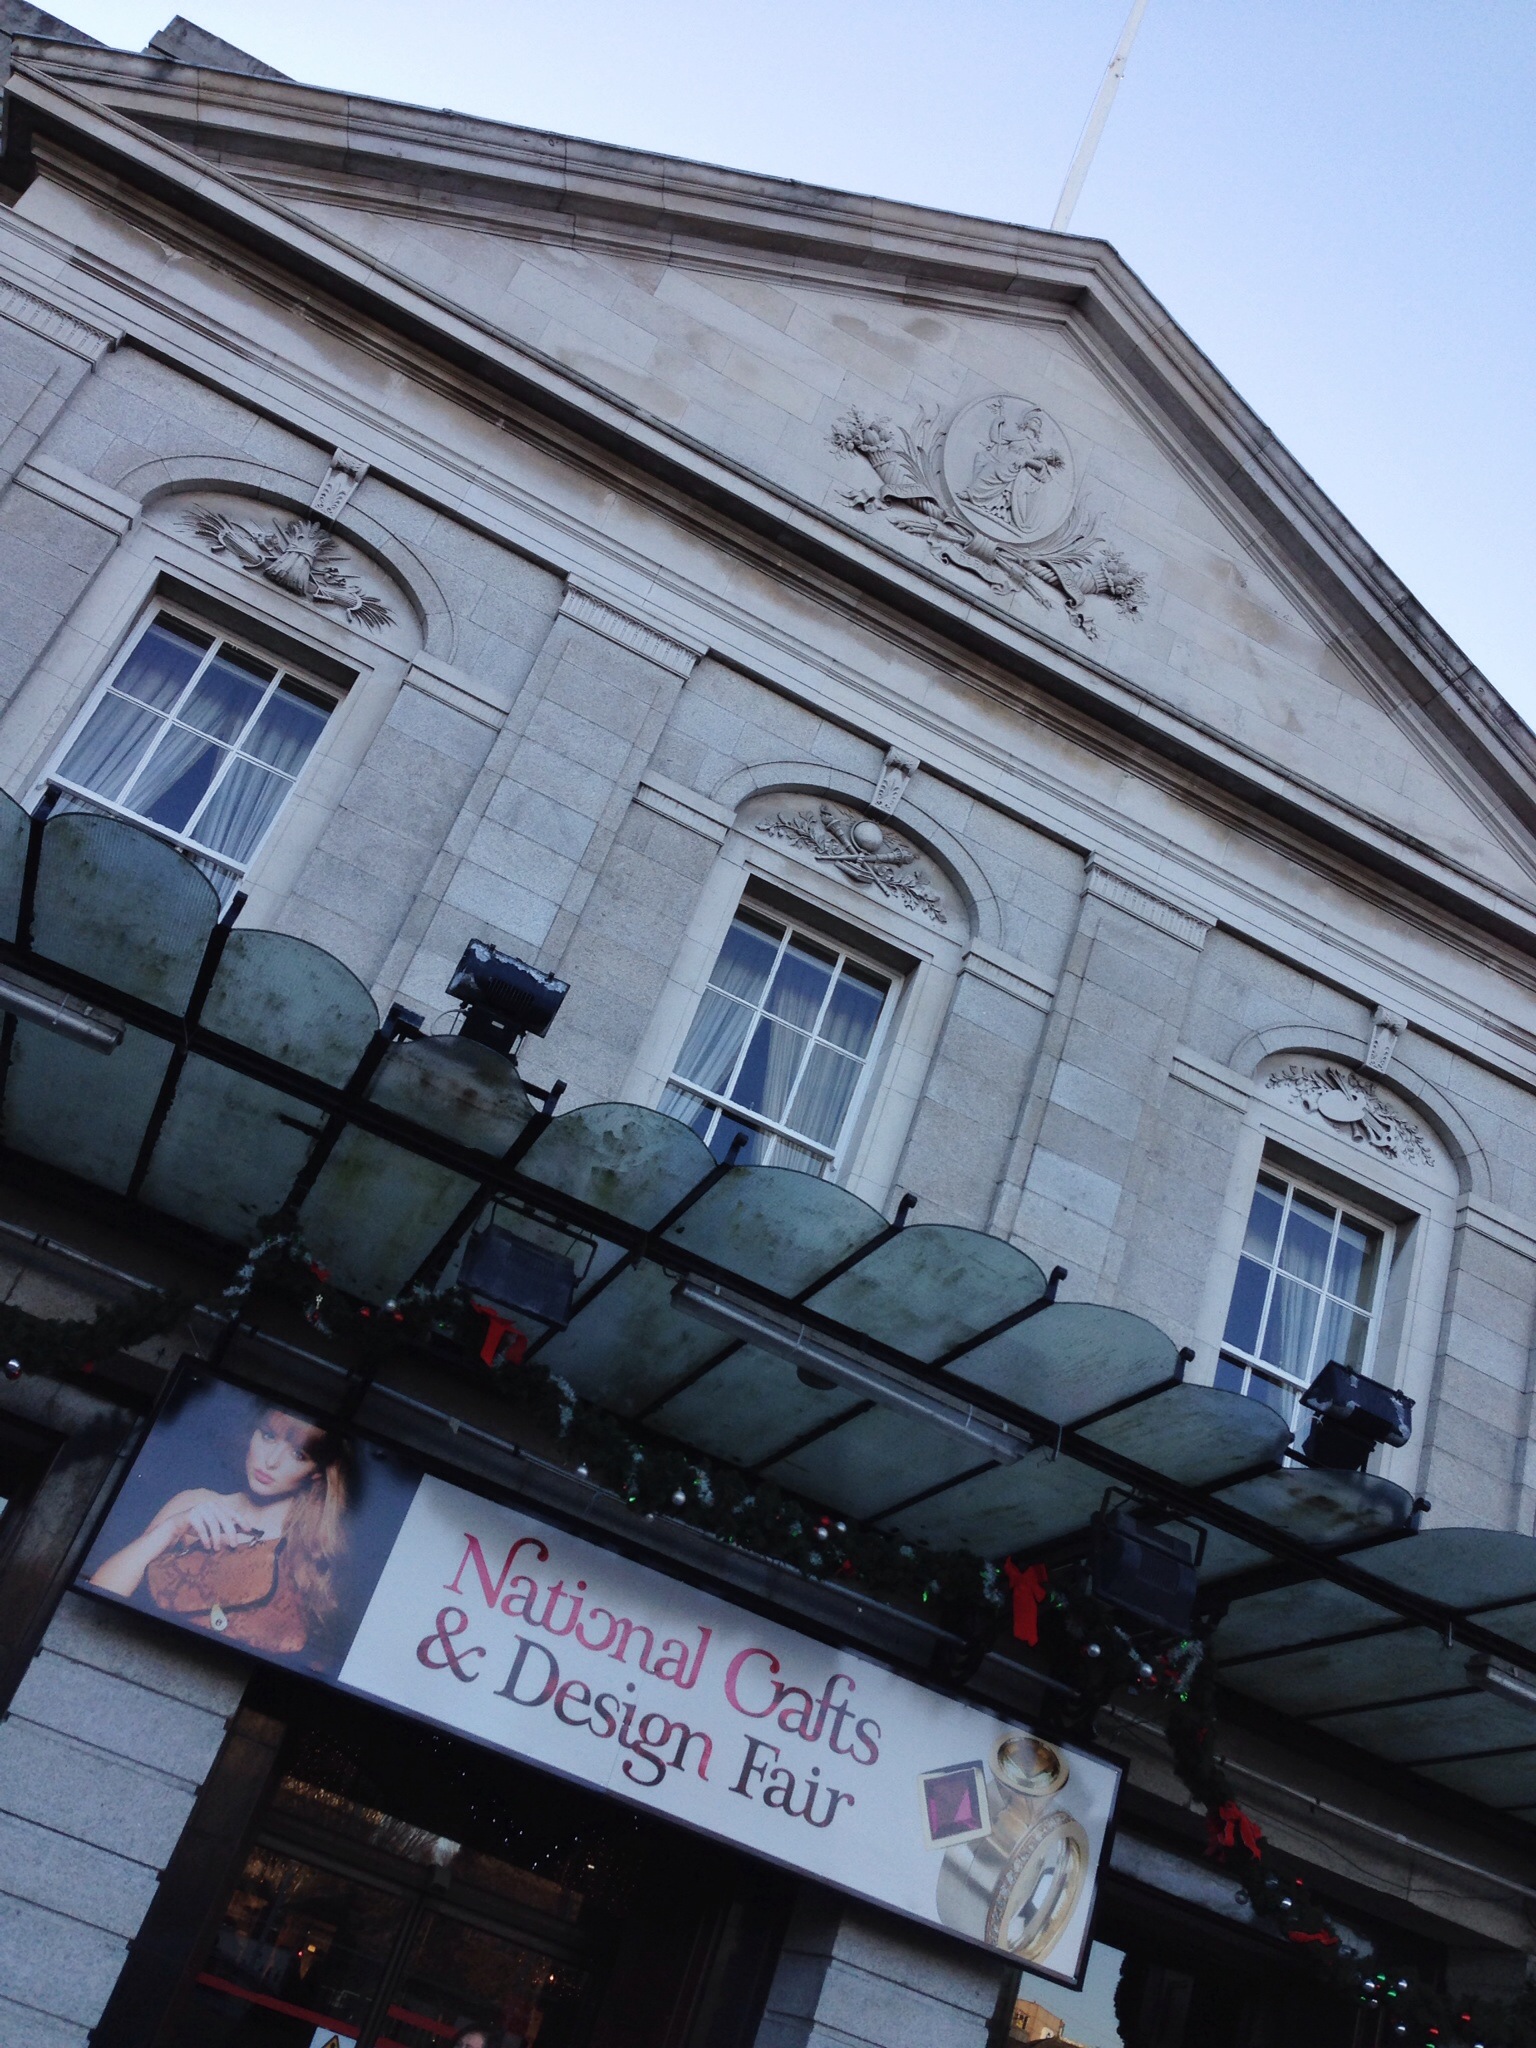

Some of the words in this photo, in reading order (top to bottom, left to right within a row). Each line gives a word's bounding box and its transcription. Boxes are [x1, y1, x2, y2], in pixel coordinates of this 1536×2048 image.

[416, 1606, 487, 1684] &
[493, 1635, 713, 1788] Design
[728, 1734, 856, 1829] Fair
[443, 1533, 712, 1690] National
[724, 1647, 882, 1766] Crafts
